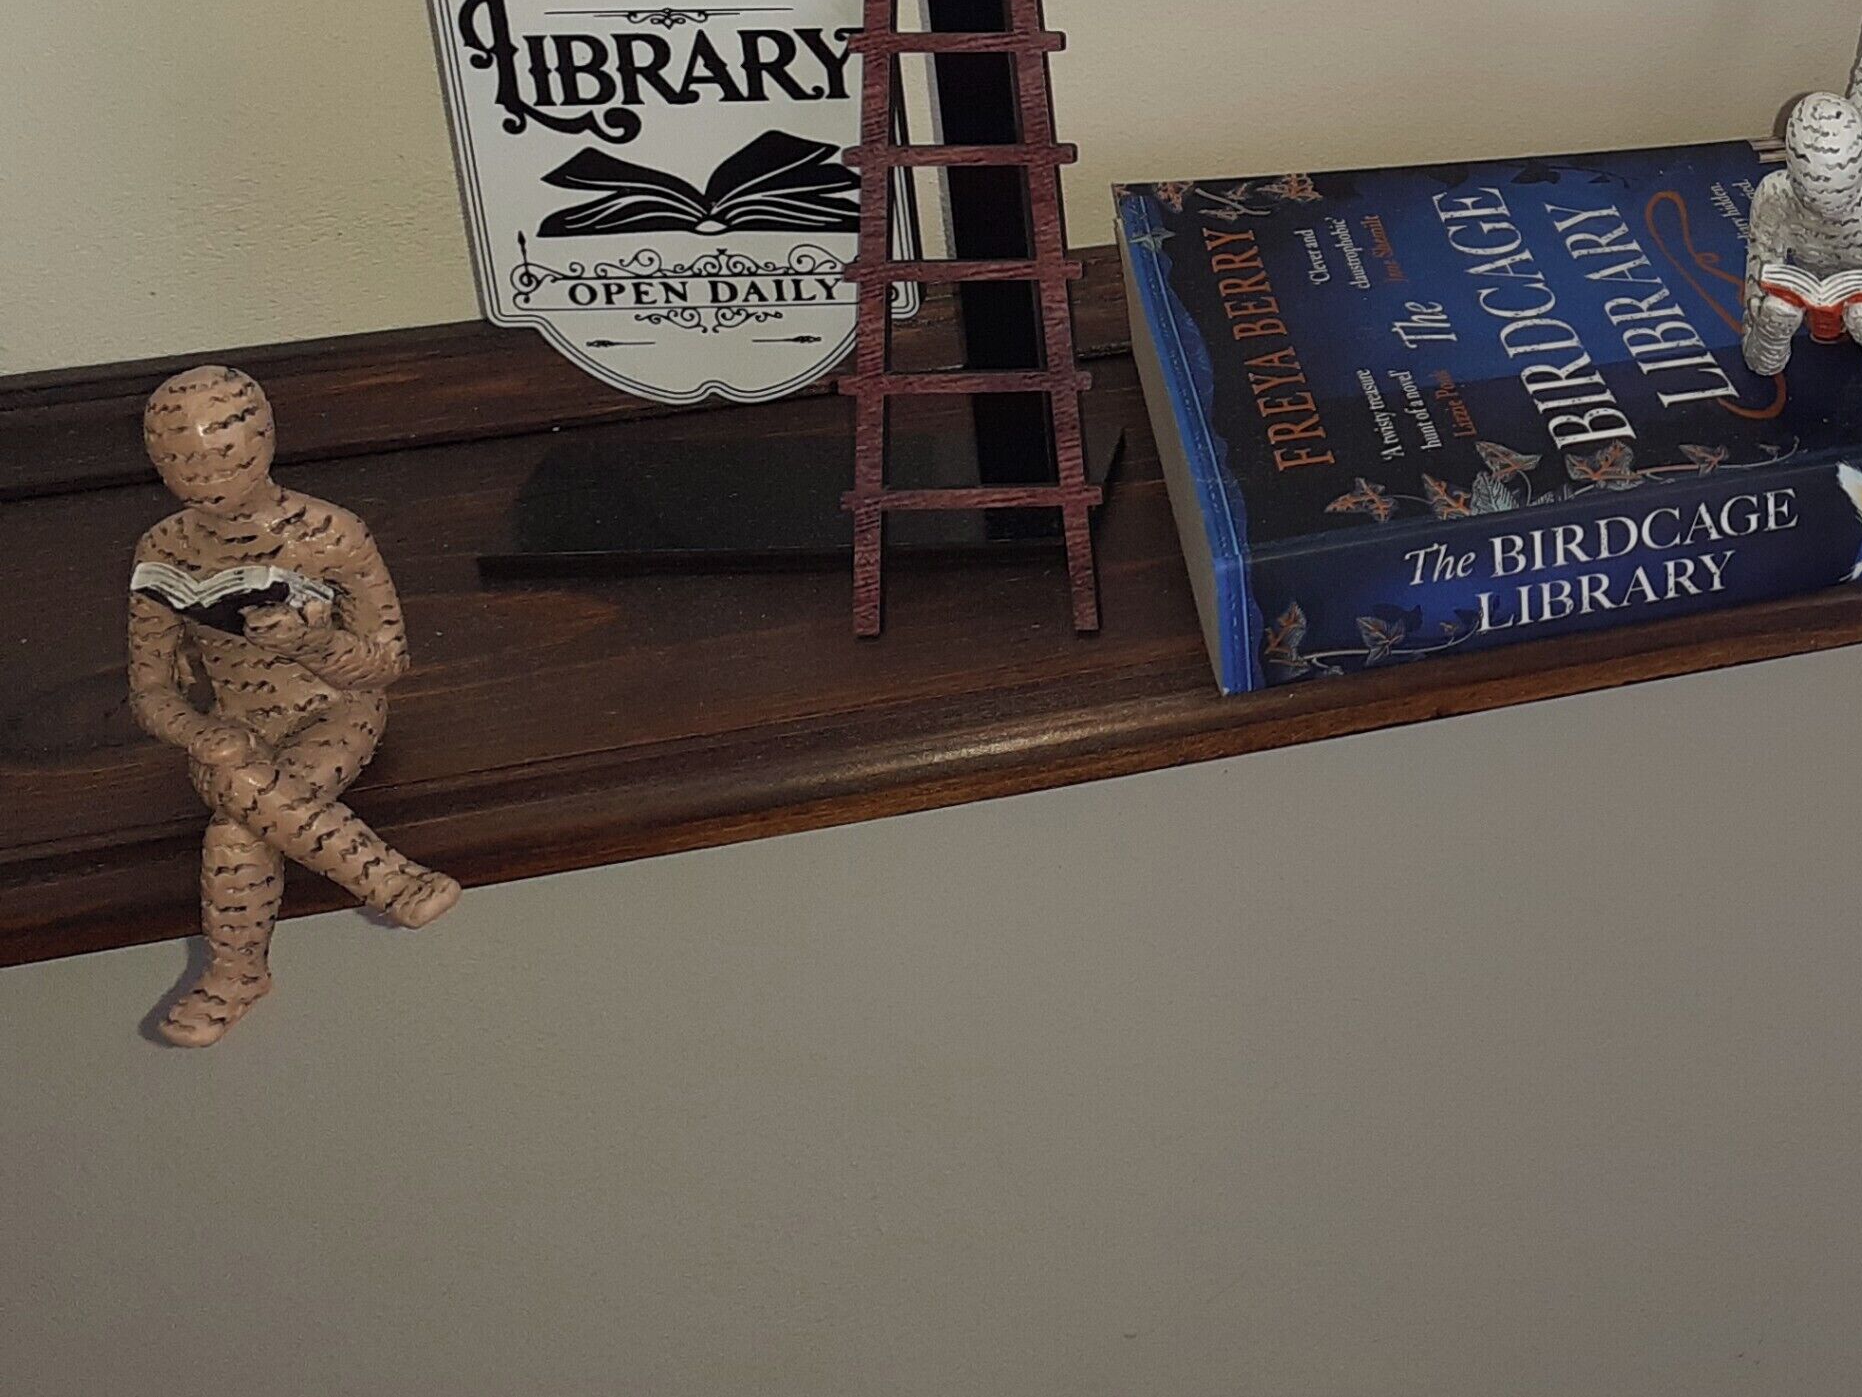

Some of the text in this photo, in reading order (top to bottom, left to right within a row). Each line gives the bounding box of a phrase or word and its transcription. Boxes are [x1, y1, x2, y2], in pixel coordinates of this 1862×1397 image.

[1293, 228, 1321, 250] and
[567, 277, 844, 307] OPEN DAILY
[1544, 202, 1740, 408] LIBRARY
[1392, 301, 1458, 349] The
[1433, 187, 1637, 450] BIRDCAGE
[1202, 227, 1335, 472] FREYA BERRY
[1356, 368, 1387, 410] treasure
[1371, 412, 1401, 444] twisty
[1404, 407, 1428, 421] of
[1415, 421, 1443, 450] hunt
[1404, 487, 1799, 586] The BIRDCAGE
[1476, 549, 1736, 635] LIBRARY
